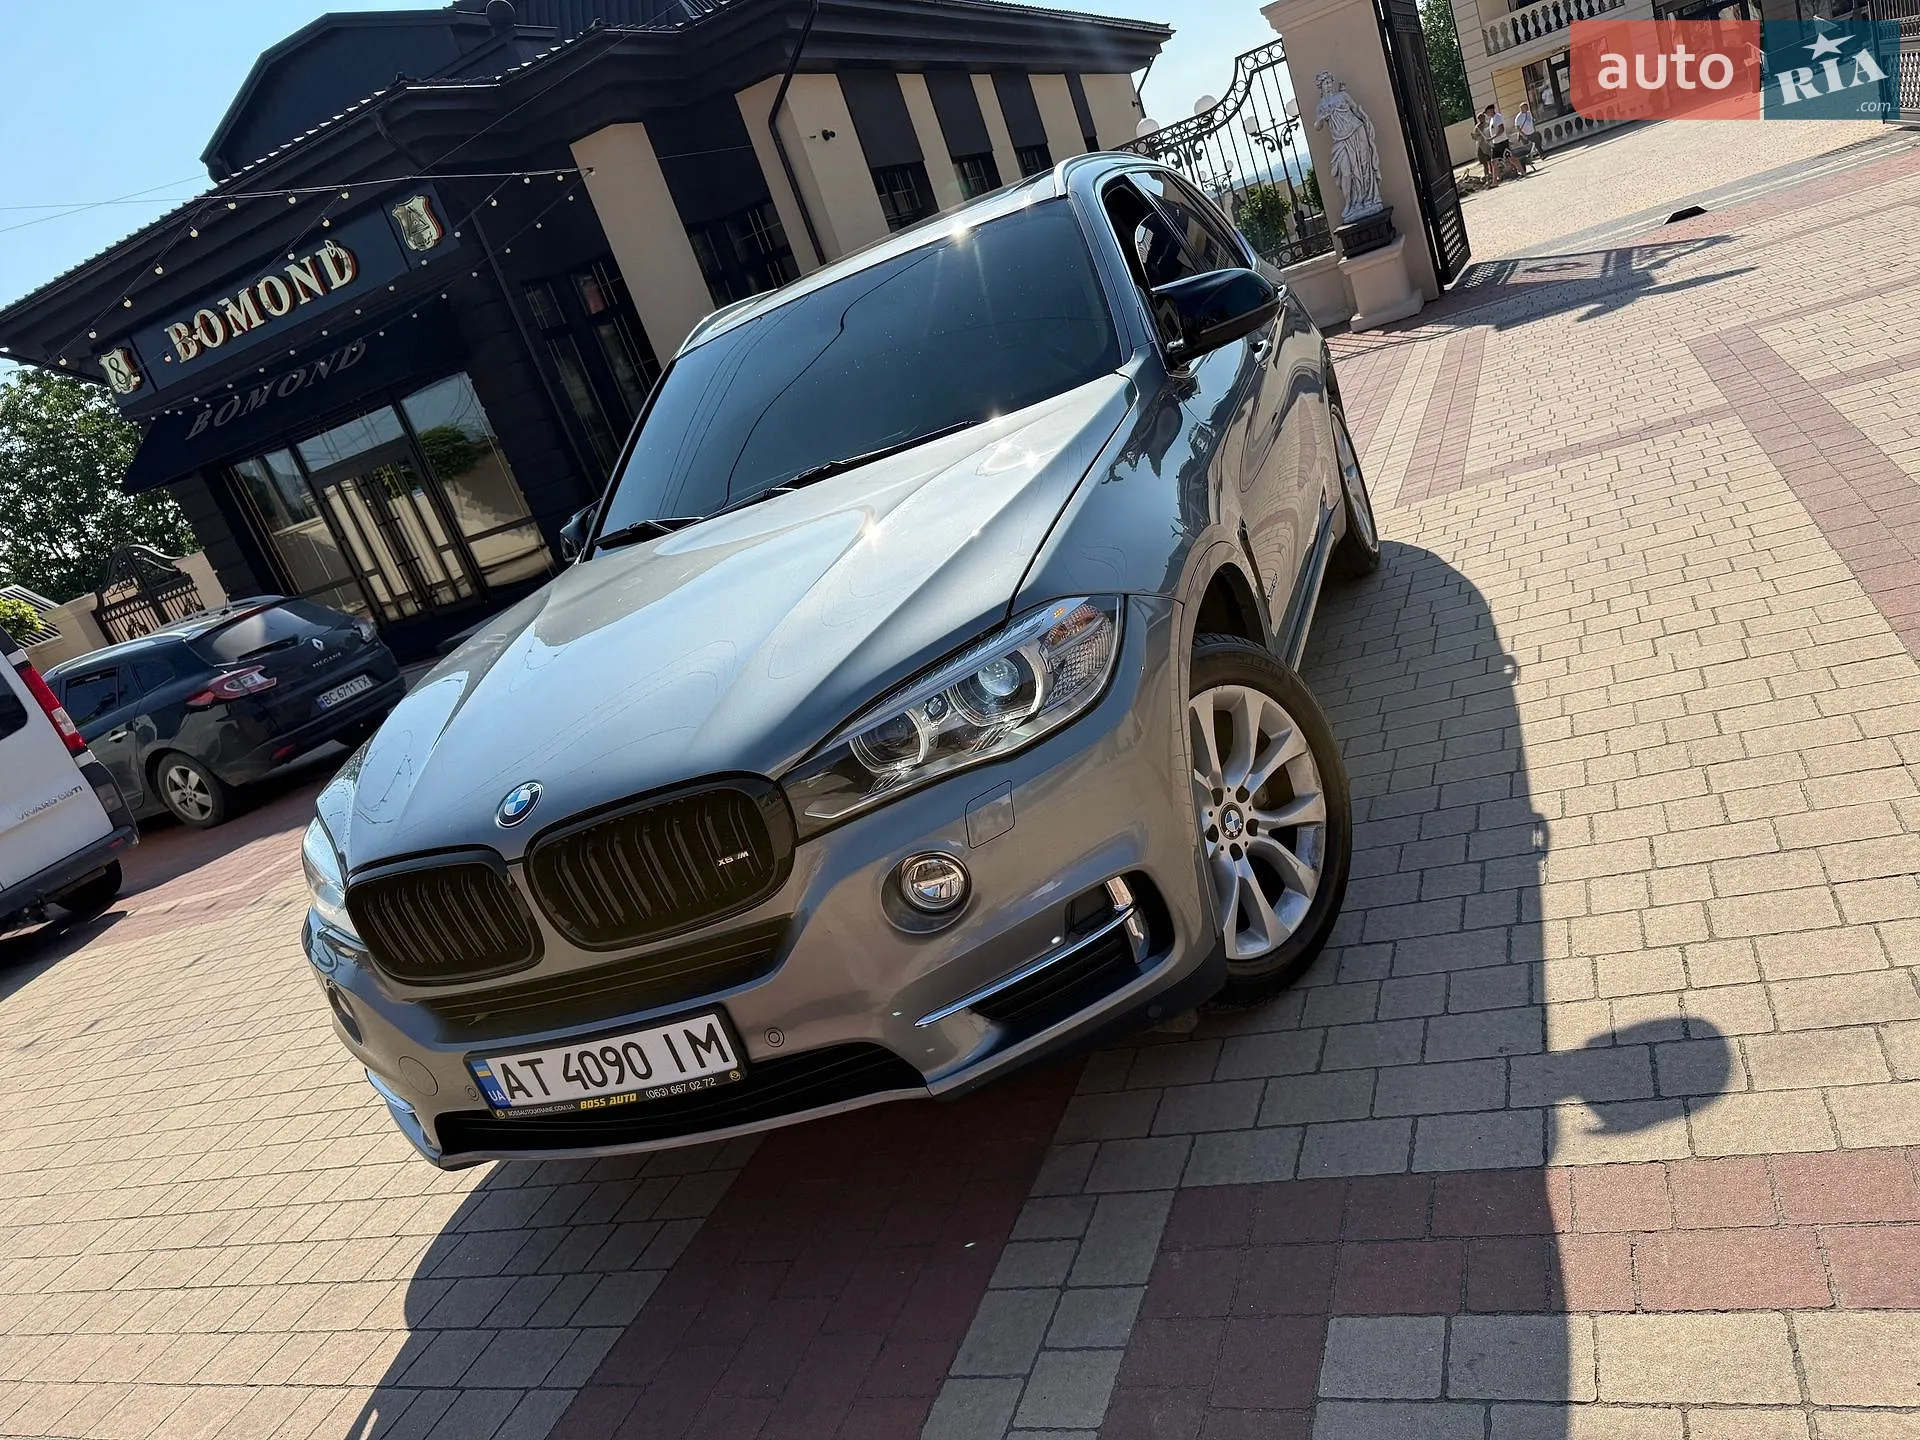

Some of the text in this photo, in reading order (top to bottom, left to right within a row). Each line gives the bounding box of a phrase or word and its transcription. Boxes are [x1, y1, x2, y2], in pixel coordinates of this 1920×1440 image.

[164, 239, 356, 363] BOMOND
[185, 337, 367, 441] BOMOND
[322, 692, 338, 705] BC
[354, 676, 370, 688] TX
[500, 1022, 729, 1100] AT 4090 IM
[487, 1090, 506, 1101] UA
[645, 1077, 716, 1099] (063) 667 02 72
[580, 1098, 606, 1110] BOSS
